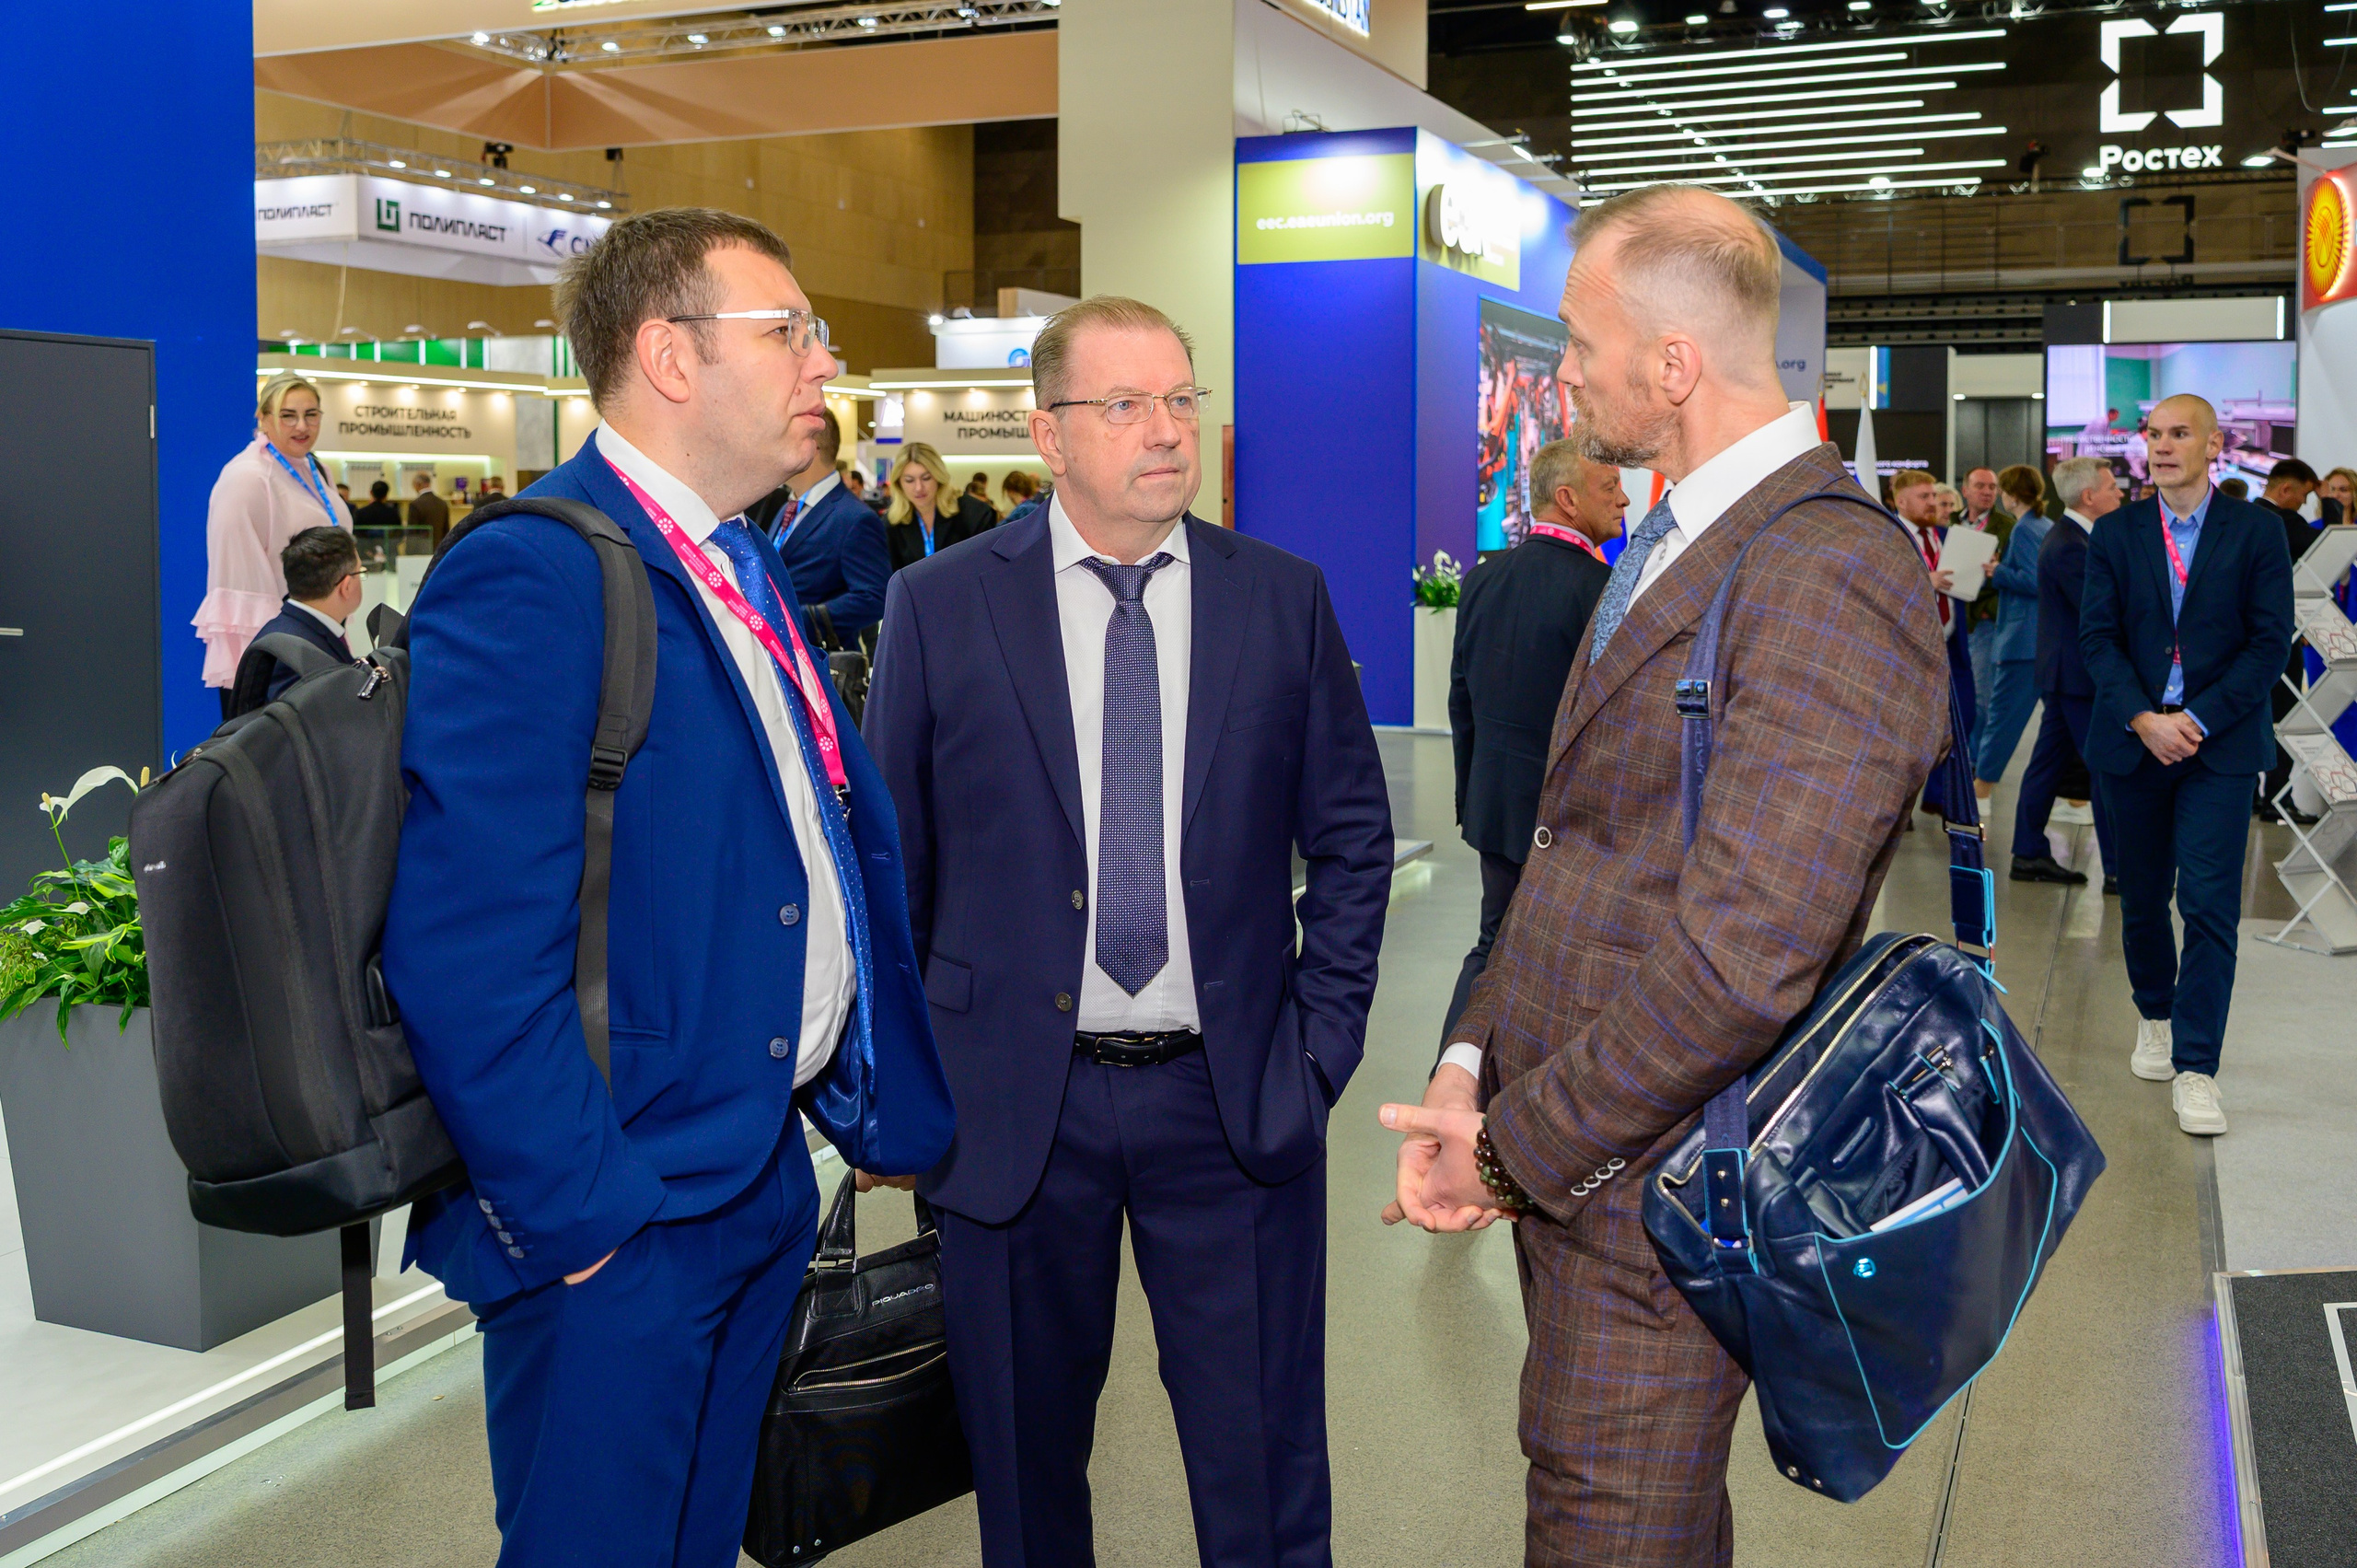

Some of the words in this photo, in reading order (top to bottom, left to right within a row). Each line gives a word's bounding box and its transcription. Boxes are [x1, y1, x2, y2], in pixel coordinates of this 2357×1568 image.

[2098, 145, 2223, 173] Ростех
[258, 203, 332, 221] ПОЛИПЛАСТ
[409, 212, 507, 242] ПОЛИПЛАСТ
[1256, 211, 1395, 231] eec.eaeunion.org
[354, 405, 457, 421] СТРОИТЕЛЬНАЯ
[944, 411, 1031, 423] МАШИНОСТ
[339, 423, 472, 439] ПРОМЫШЛЕННОСТЬ
[958, 427, 1029, 439] ПРОМЫШ
